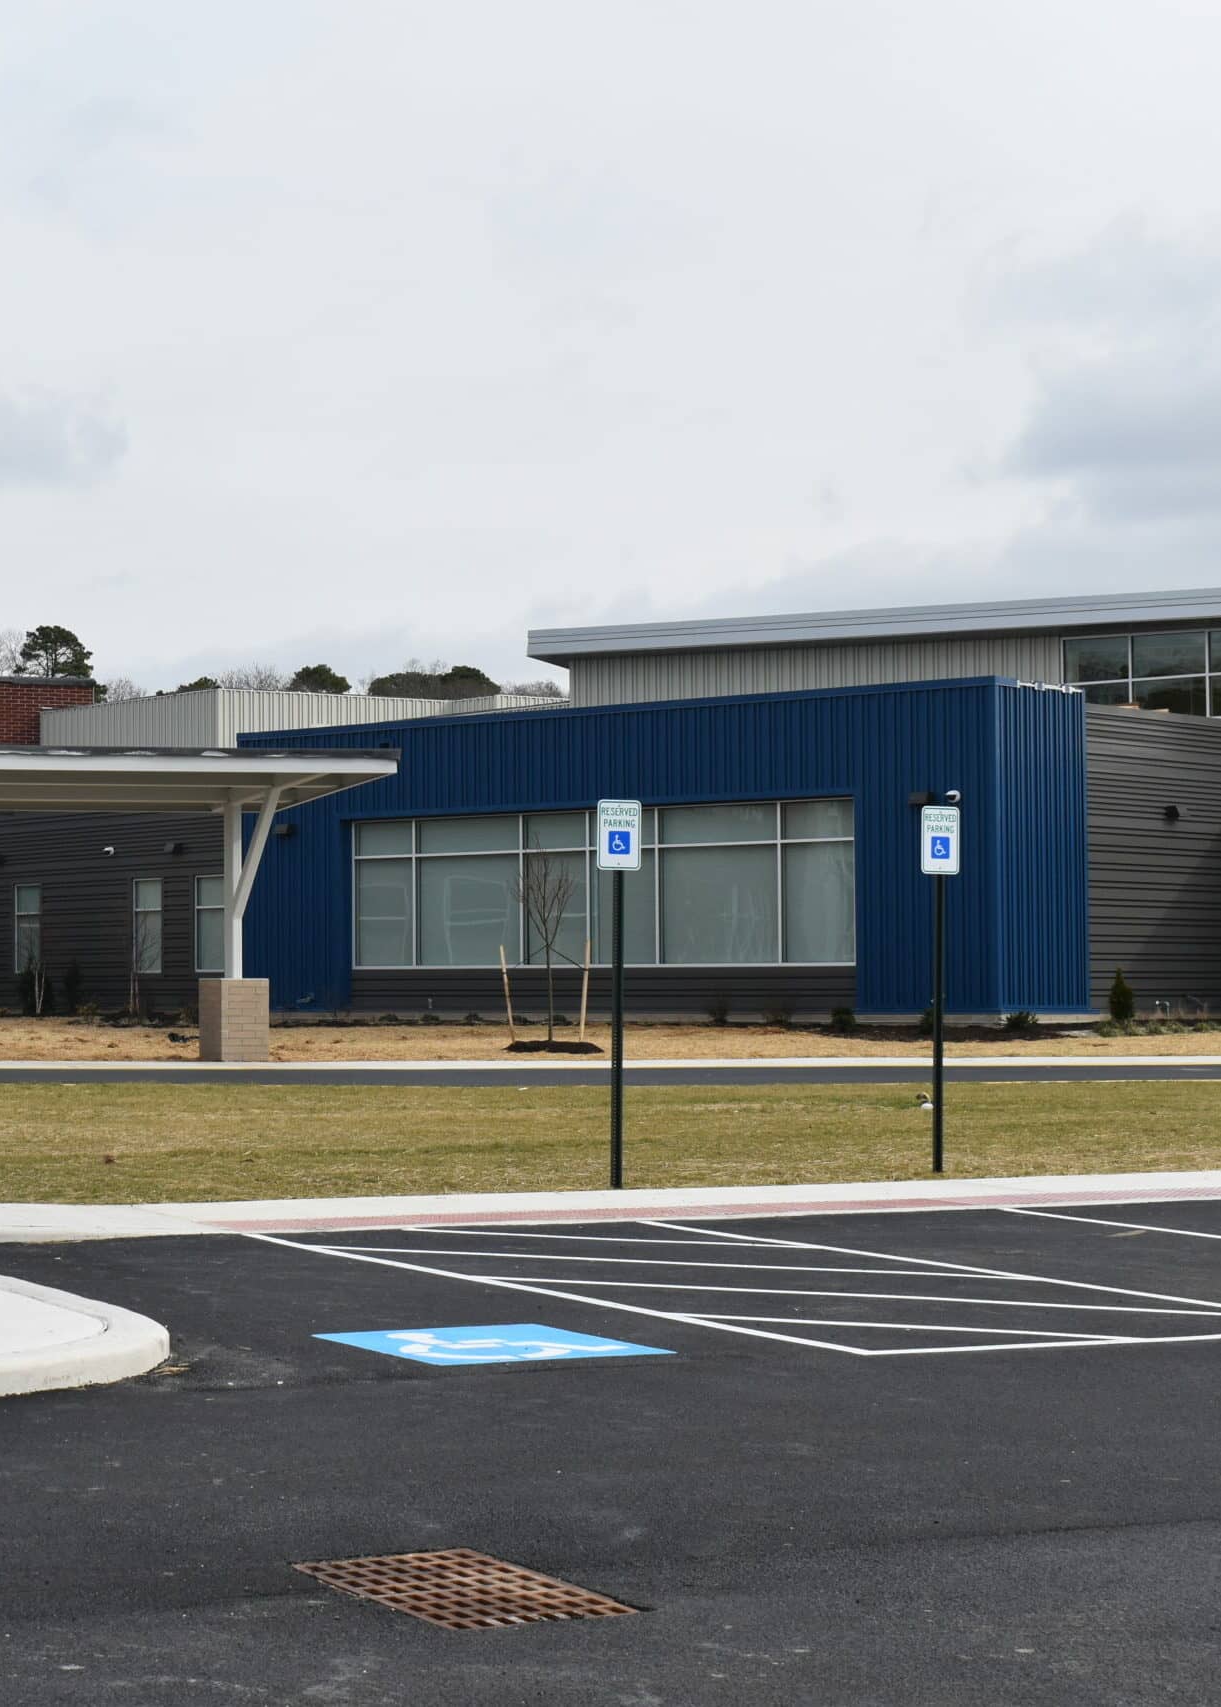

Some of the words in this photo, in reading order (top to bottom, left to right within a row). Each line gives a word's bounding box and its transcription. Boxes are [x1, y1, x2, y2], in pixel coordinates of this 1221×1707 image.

[601, 806, 638, 817] RESERVED
[924, 813, 957, 823] RESERVED
[603, 818, 636, 829] PARKING
[926, 824, 955, 834] PARKING
